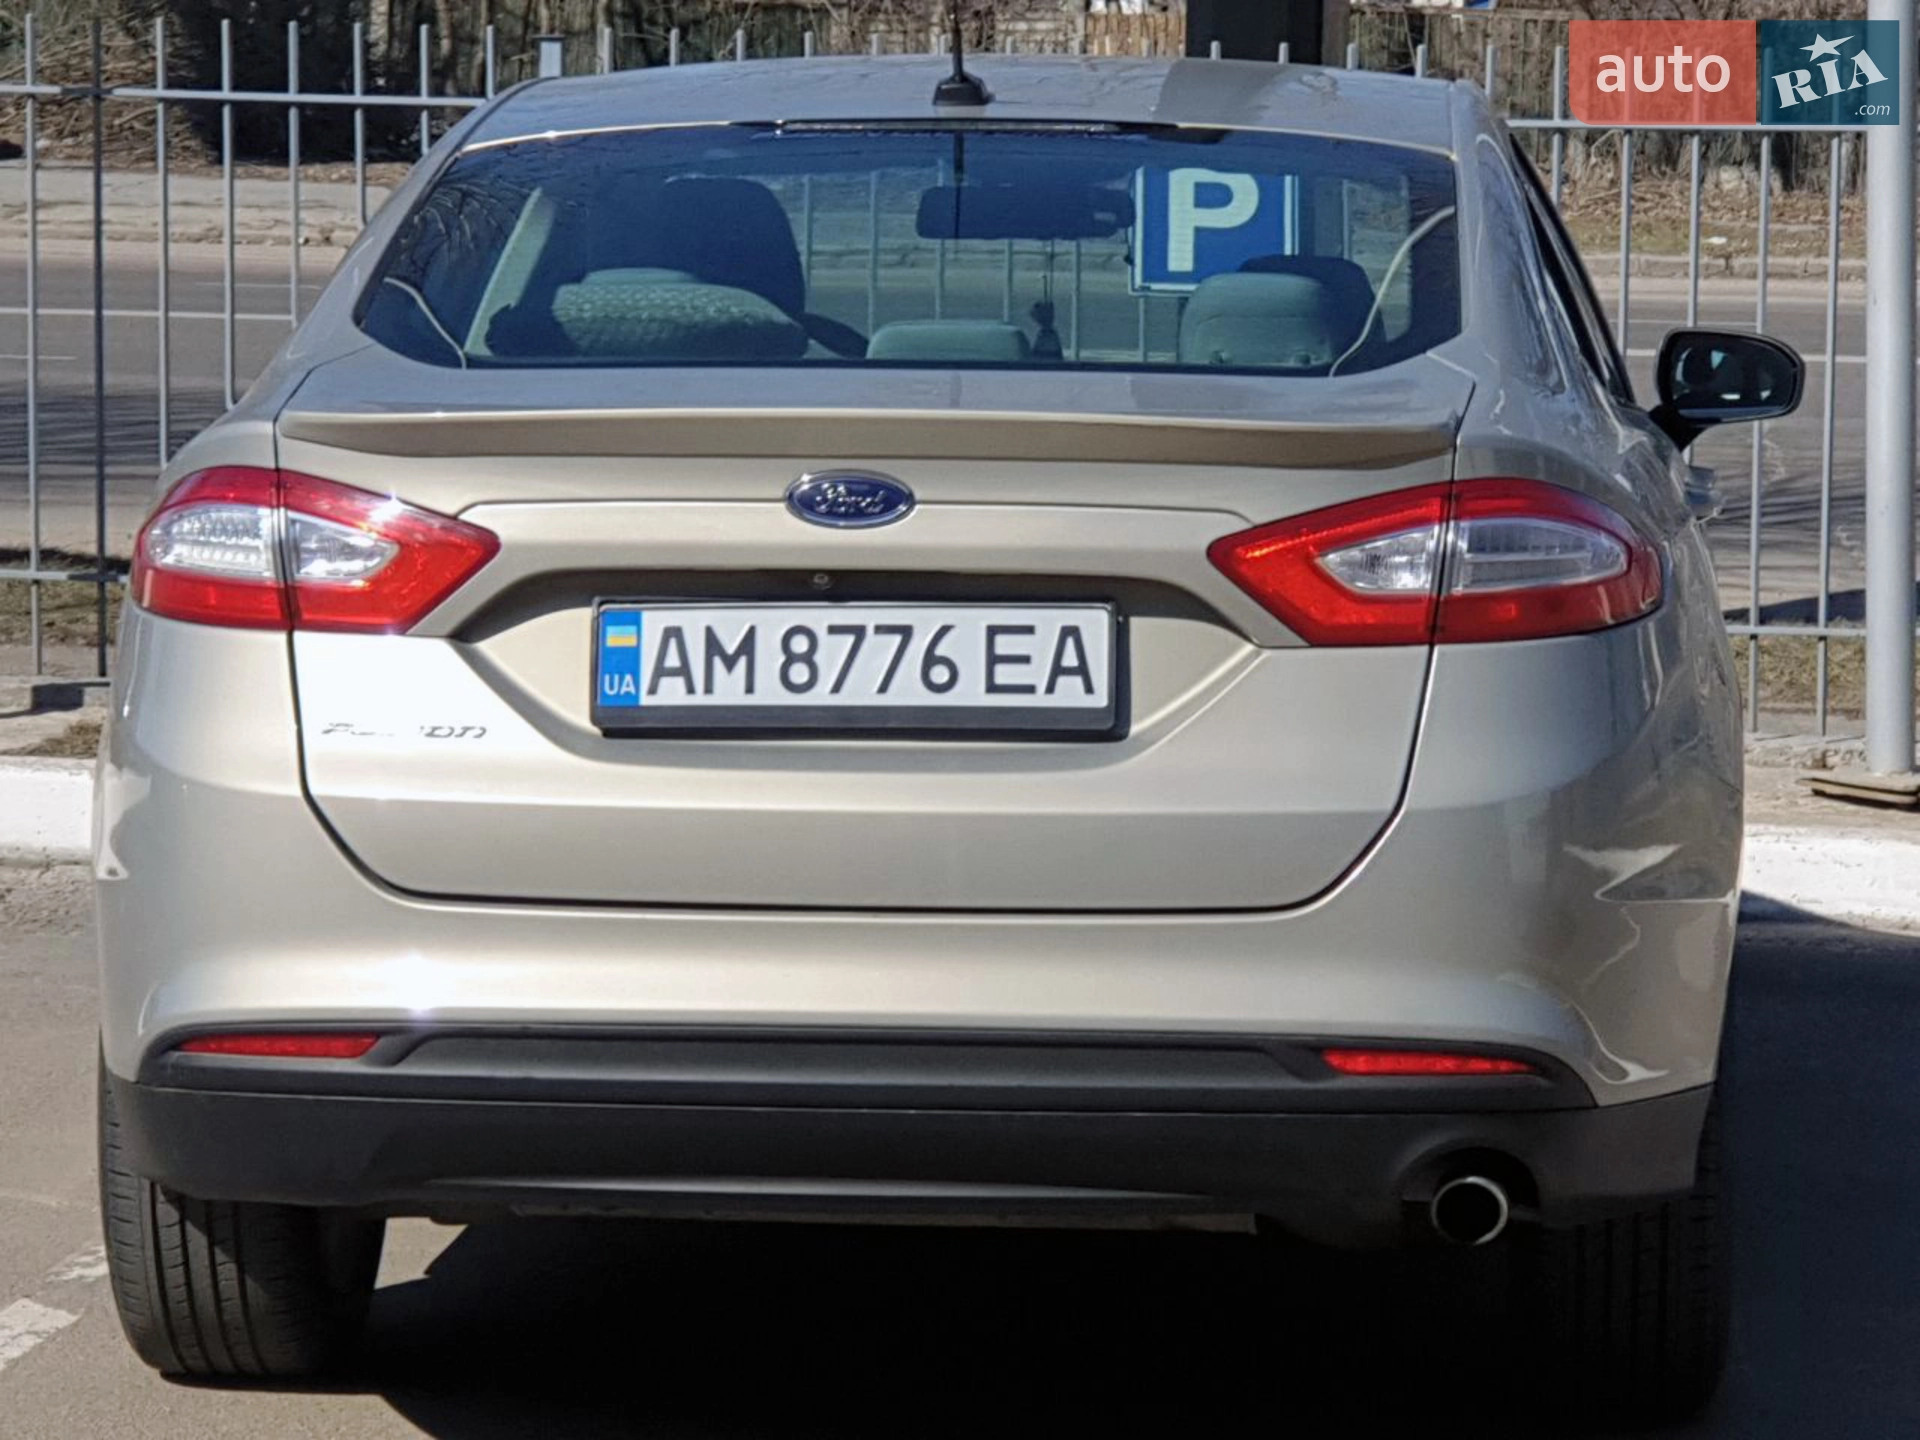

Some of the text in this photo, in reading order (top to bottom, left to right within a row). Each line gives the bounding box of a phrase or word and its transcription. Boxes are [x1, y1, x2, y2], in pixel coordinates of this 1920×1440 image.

[1167, 167, 1260, 273] P
[814, 482, 888, 514] Ford
[603, 672, 637, 696] UA
[646, 623, 1095, 695] AM 8776 EA
